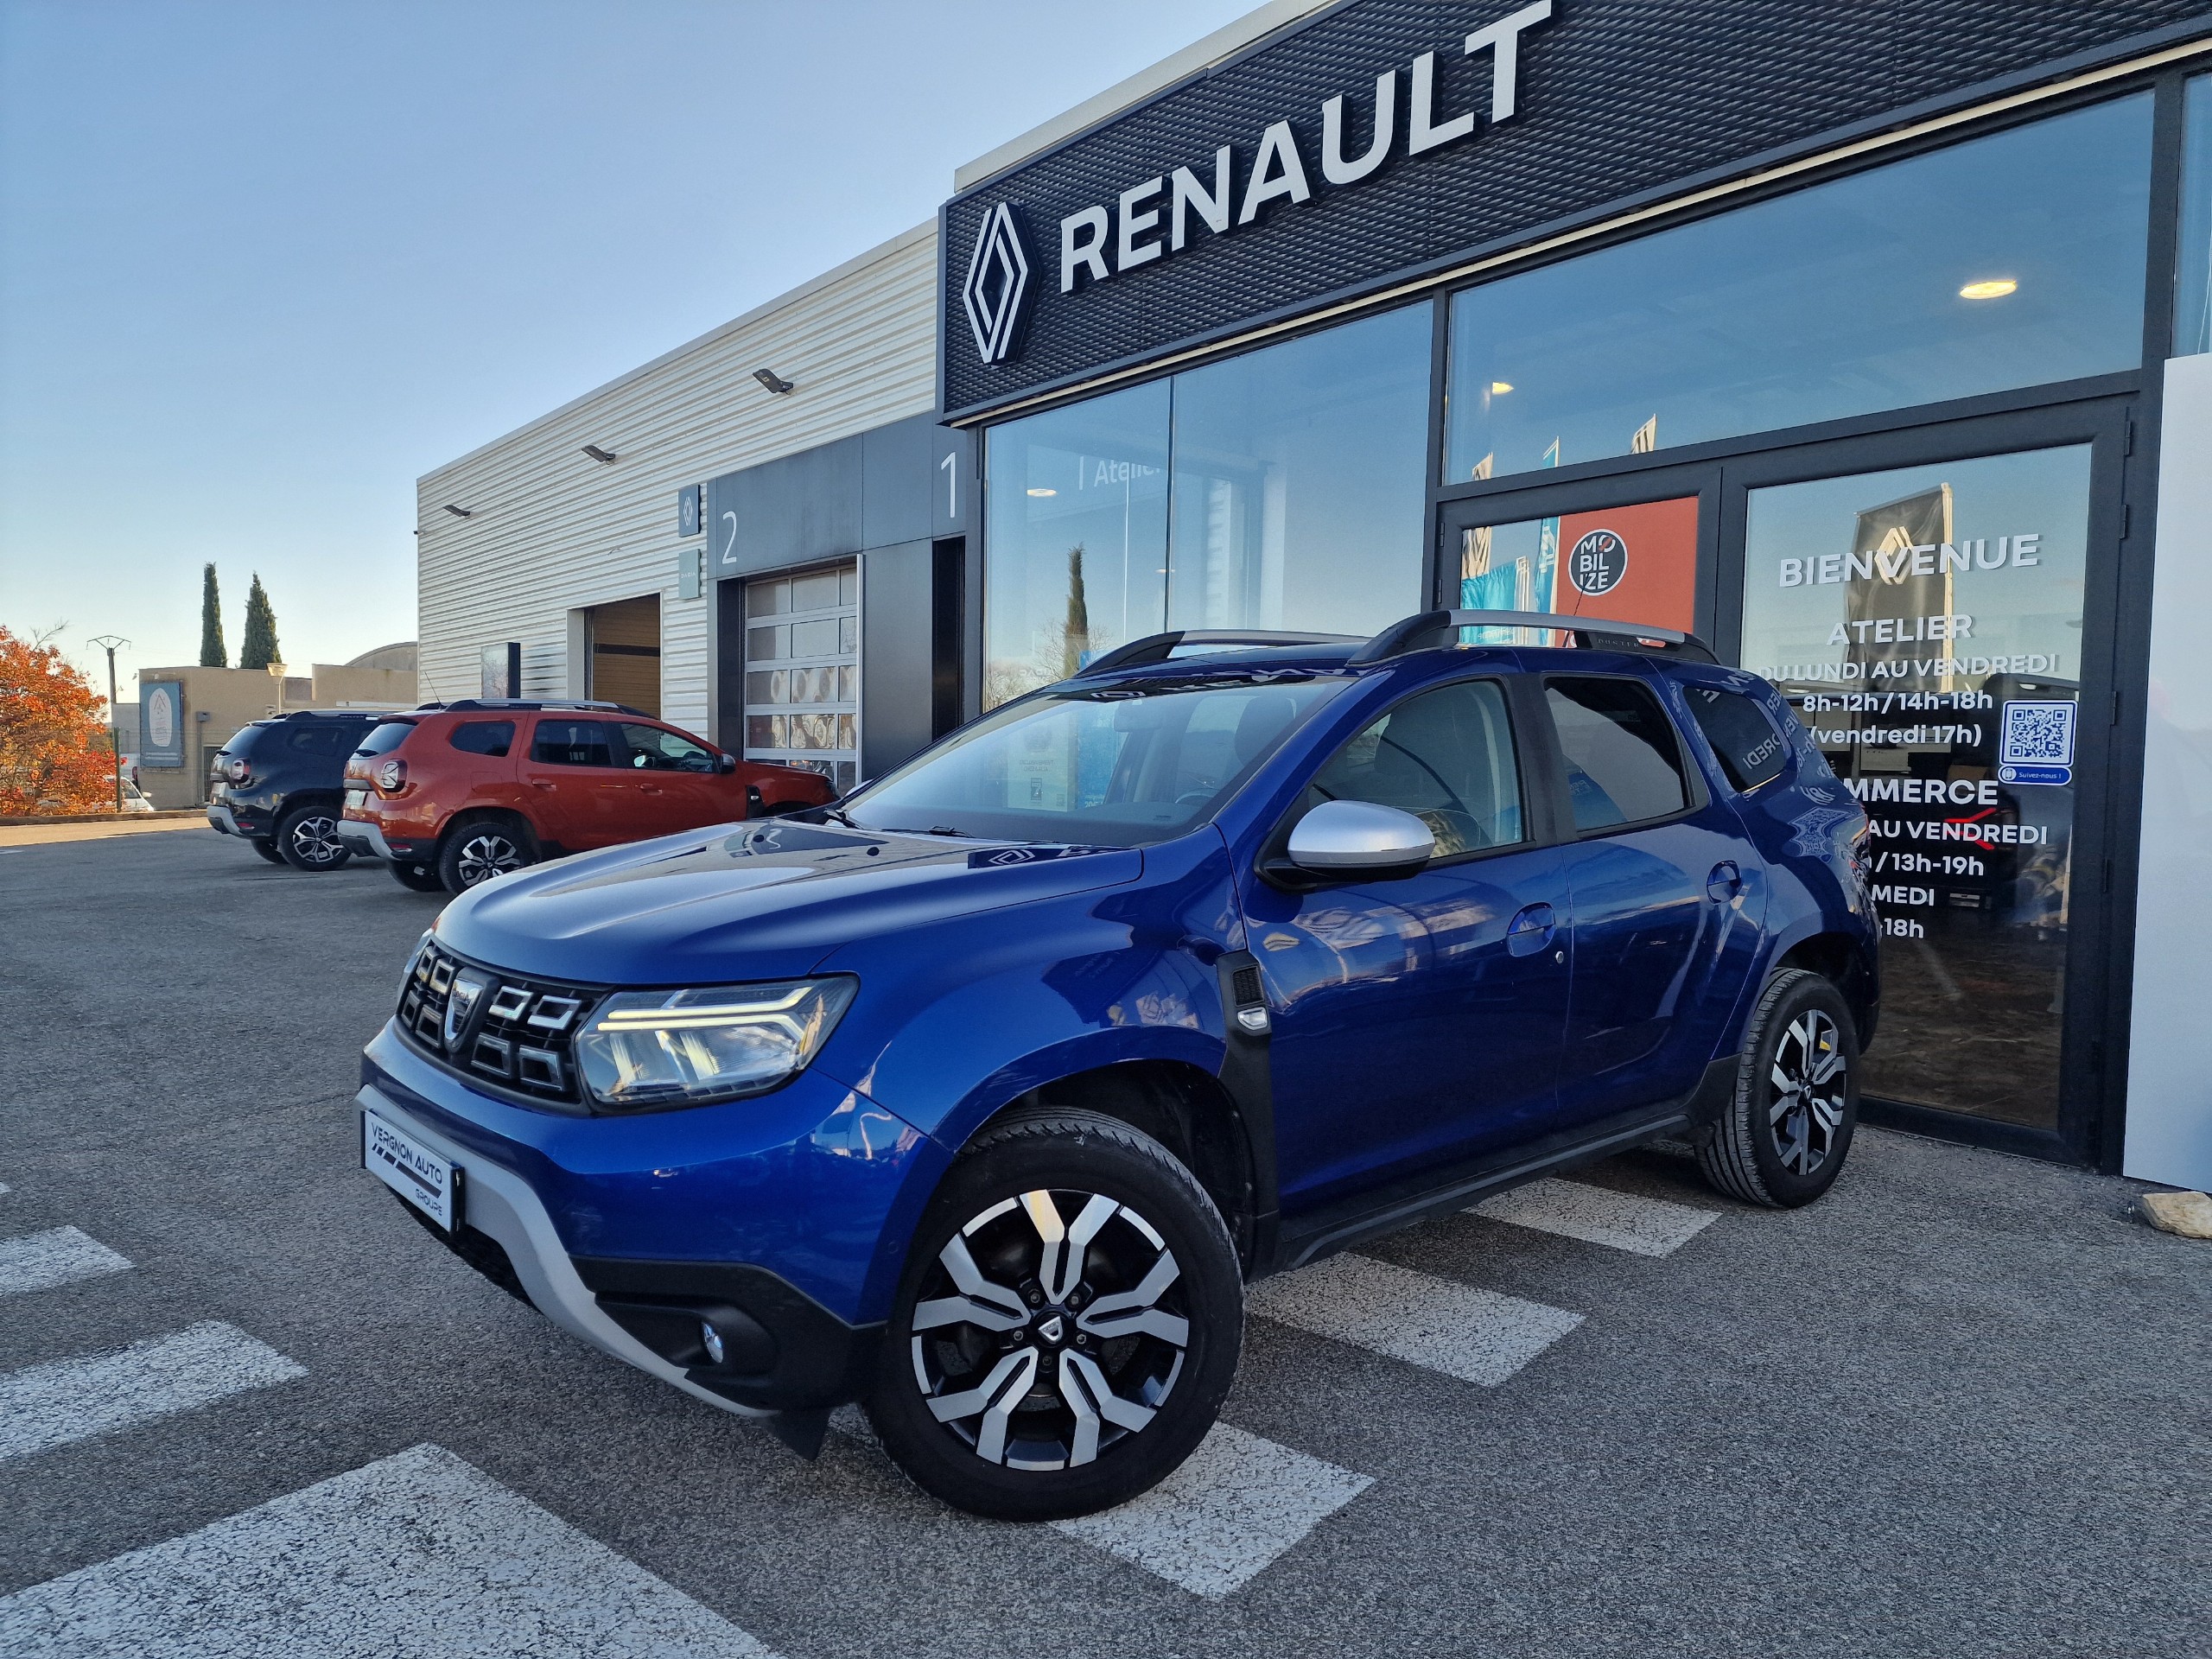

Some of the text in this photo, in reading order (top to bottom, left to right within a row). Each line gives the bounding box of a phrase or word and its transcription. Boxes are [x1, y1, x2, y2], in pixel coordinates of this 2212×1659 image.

[1060, 0, 1552, 293] RENAULT
[940, 452, 957, 518] 1
[1094, 460, 1160, 487] Atelie
[721, 511, 737, 564] 2
[1779, 533, 2040, 588] BIENVENUE
[1826, 613, 1974, 645] ATELIER
[1760, 653, 2056, 682] DU LUNDI AU VENDREDI
[1803, 693, 1879, 713] 8h-12h
[1897, 690, 1993, 712] 14h-18h
[1810, 723, 1926, 746] (vendredi
[1933, 723, 1982, 747] 17h)
[1844, 778, 1999, 805] MMERCE
[1869, 820, 2048, 845] AU VENDREDI
[1892, 853, 1985, 876] 13h-19h
[1871, 884, 1935, 906] MEDI
[371, 1122, 442, 1185] VERGNON AUTO
[415, 1188, 442, 1217] GROUPE
